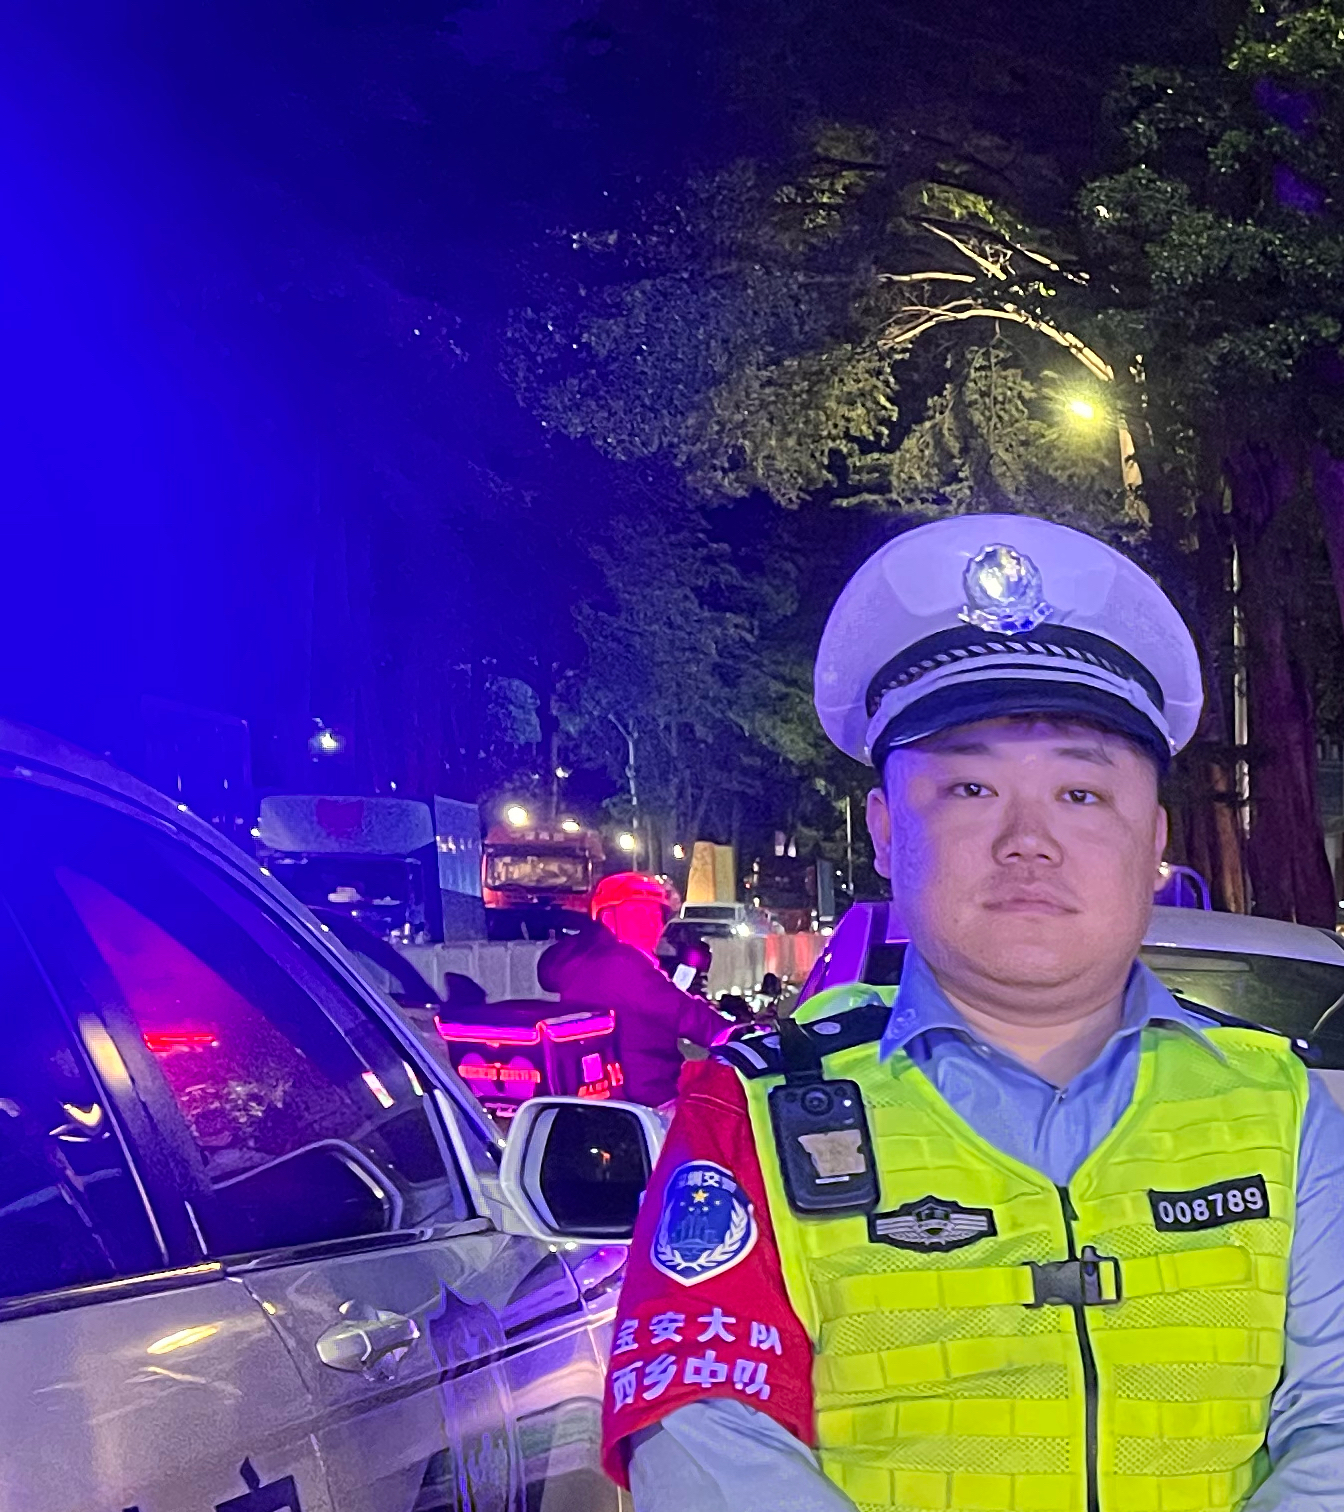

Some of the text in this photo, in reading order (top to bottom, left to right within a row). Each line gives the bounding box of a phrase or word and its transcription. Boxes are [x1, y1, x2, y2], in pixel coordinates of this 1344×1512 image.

[1158, 1186, 1263, 1224] 008789
[612, 1307, 782, 1355] 宝安大队
[612, 1349, 771, 1413] 西乡中队
